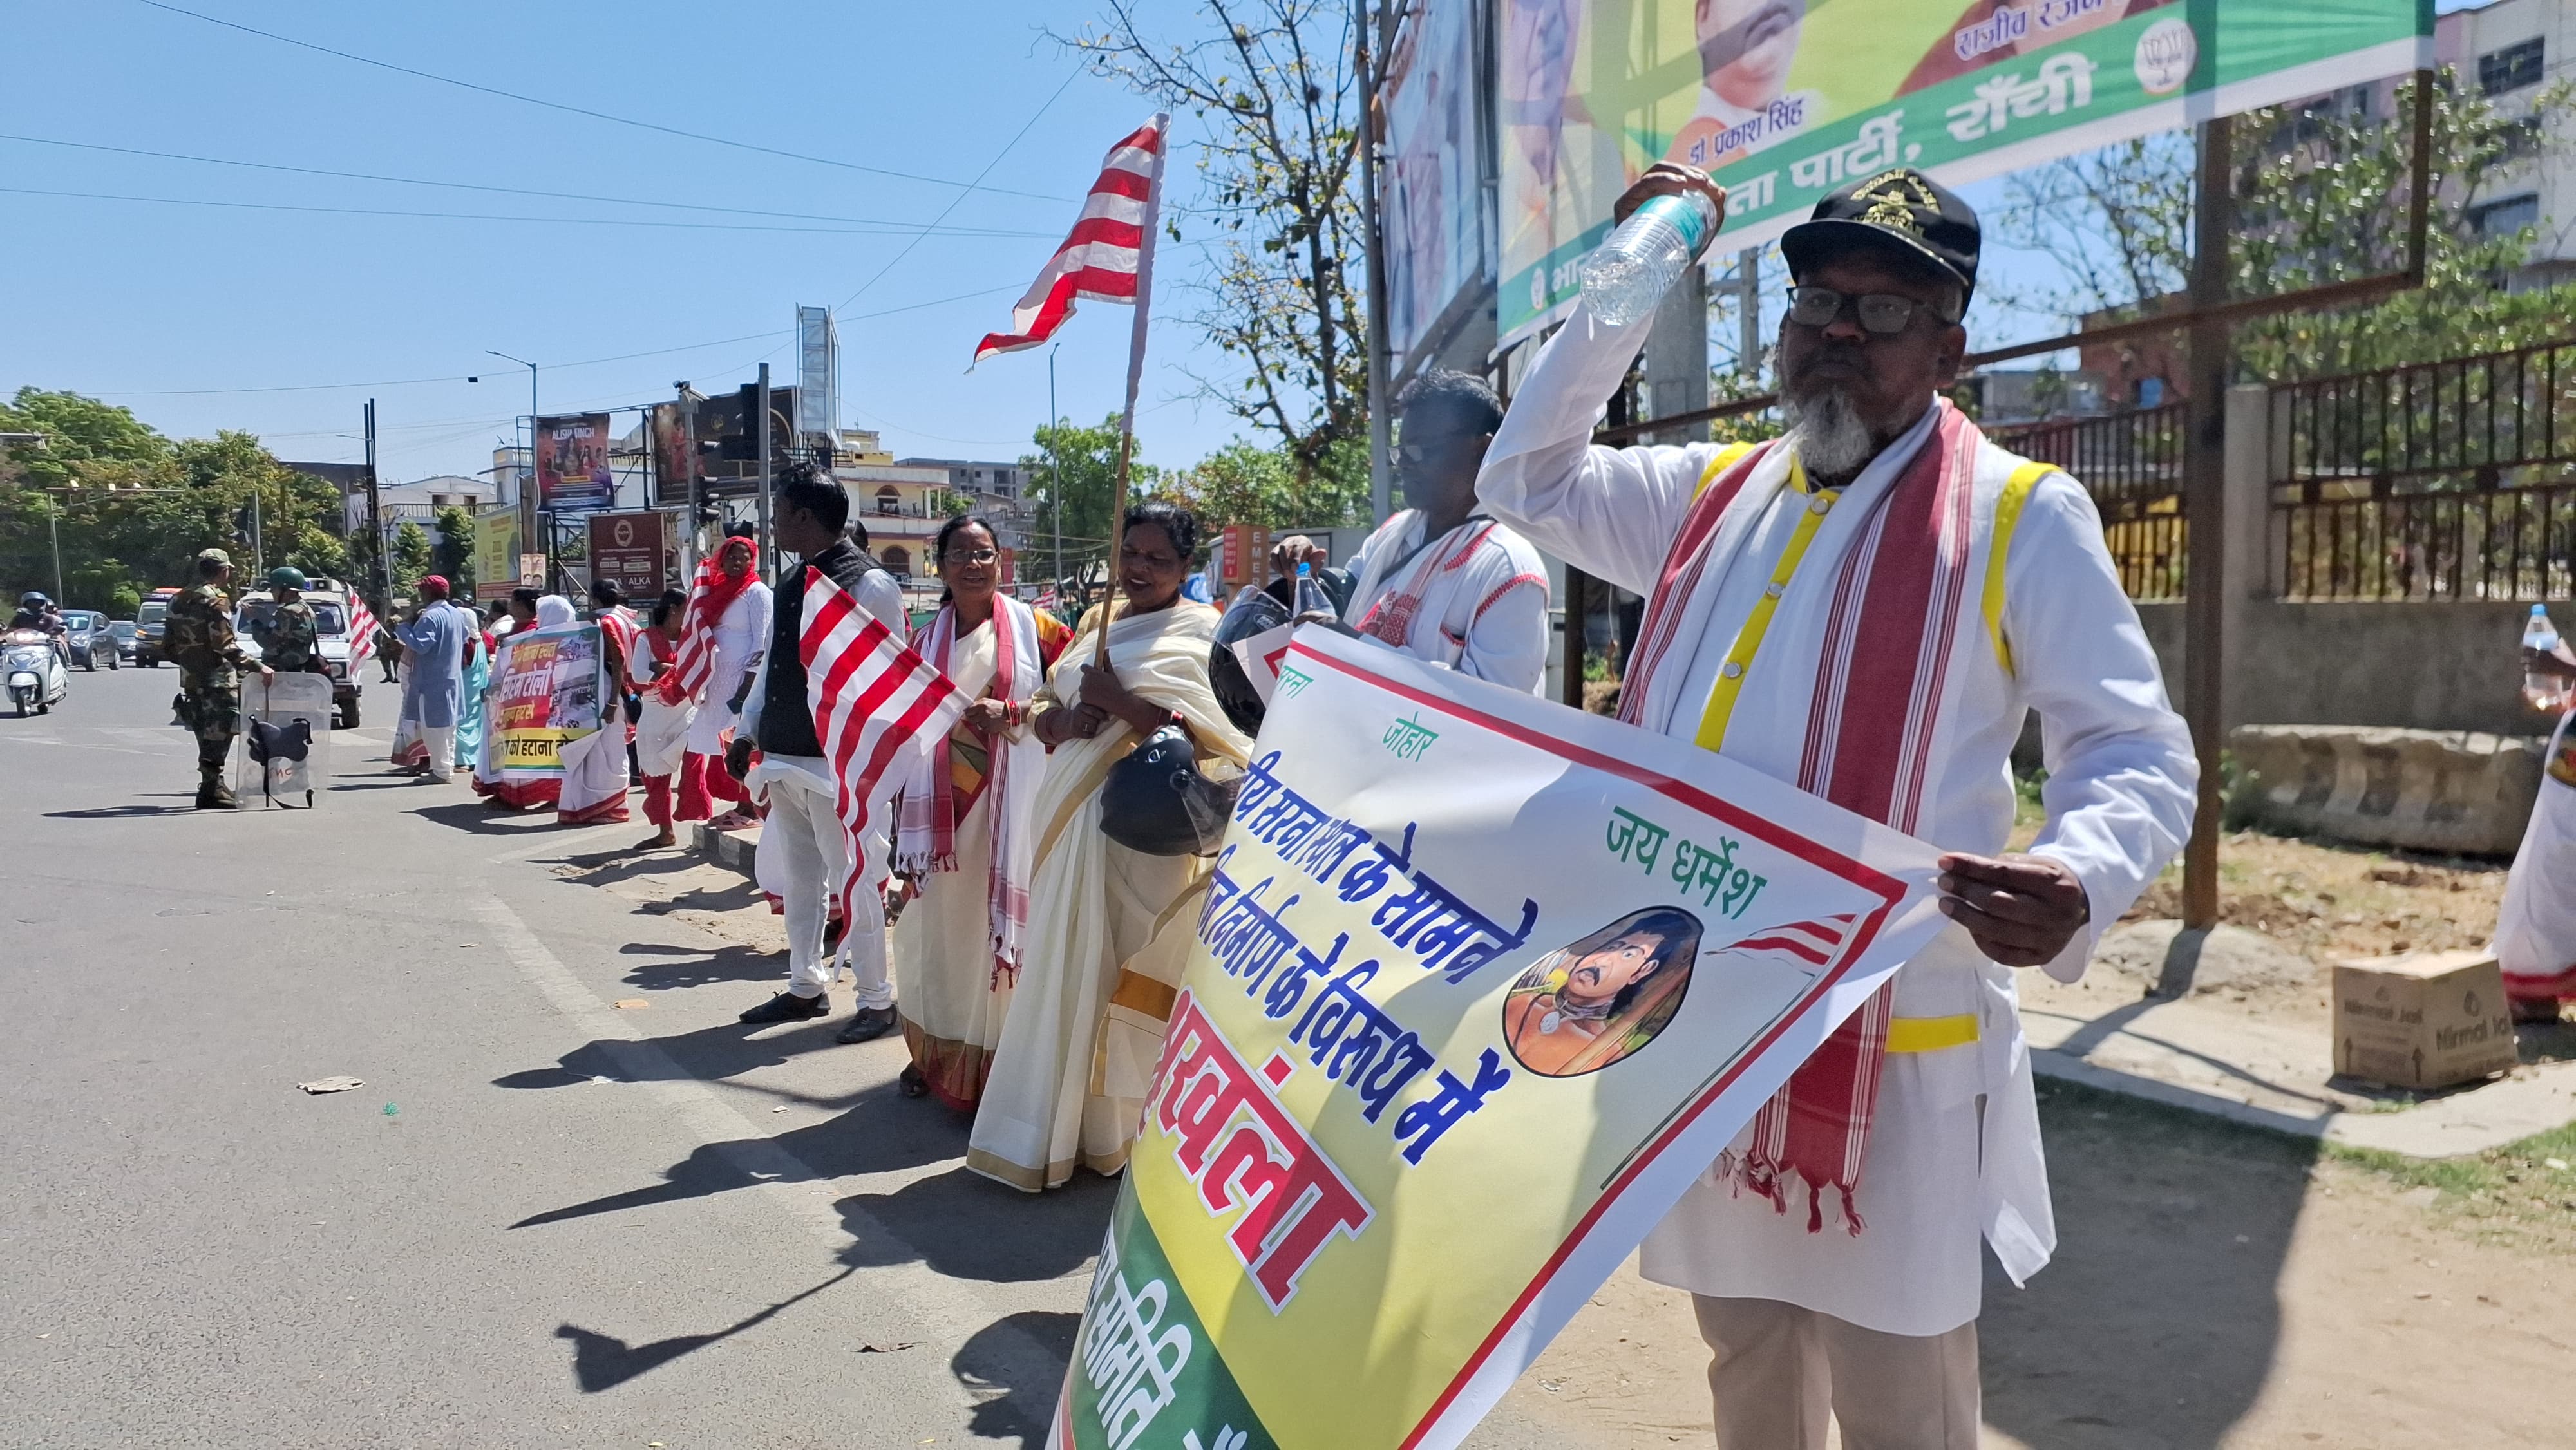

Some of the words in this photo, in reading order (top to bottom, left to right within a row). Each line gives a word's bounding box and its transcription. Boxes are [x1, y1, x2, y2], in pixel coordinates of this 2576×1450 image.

[1768, 96, 1804, 133] सिंह
[574, 427, 595, 439] SINGH
[628, 576, 651, 585] ALKA
[522, 739, 554, 757] हटाना
[1382, 710, 1439, 763] जोहार
[1337, 820, 1418, 903] के
[1606, 805, 1670, 876] जय
[1671, 835, 1768, 921] धर्मेश
[1370, 868, 1540, 986] सामने
[1210, 875, 1300, 999] निर्माण
[1263, 930, 1350, 1021] के
[1393, 1046, 1512, 1168] में
[2436, 1019, 2488, 1051] Nirmal
